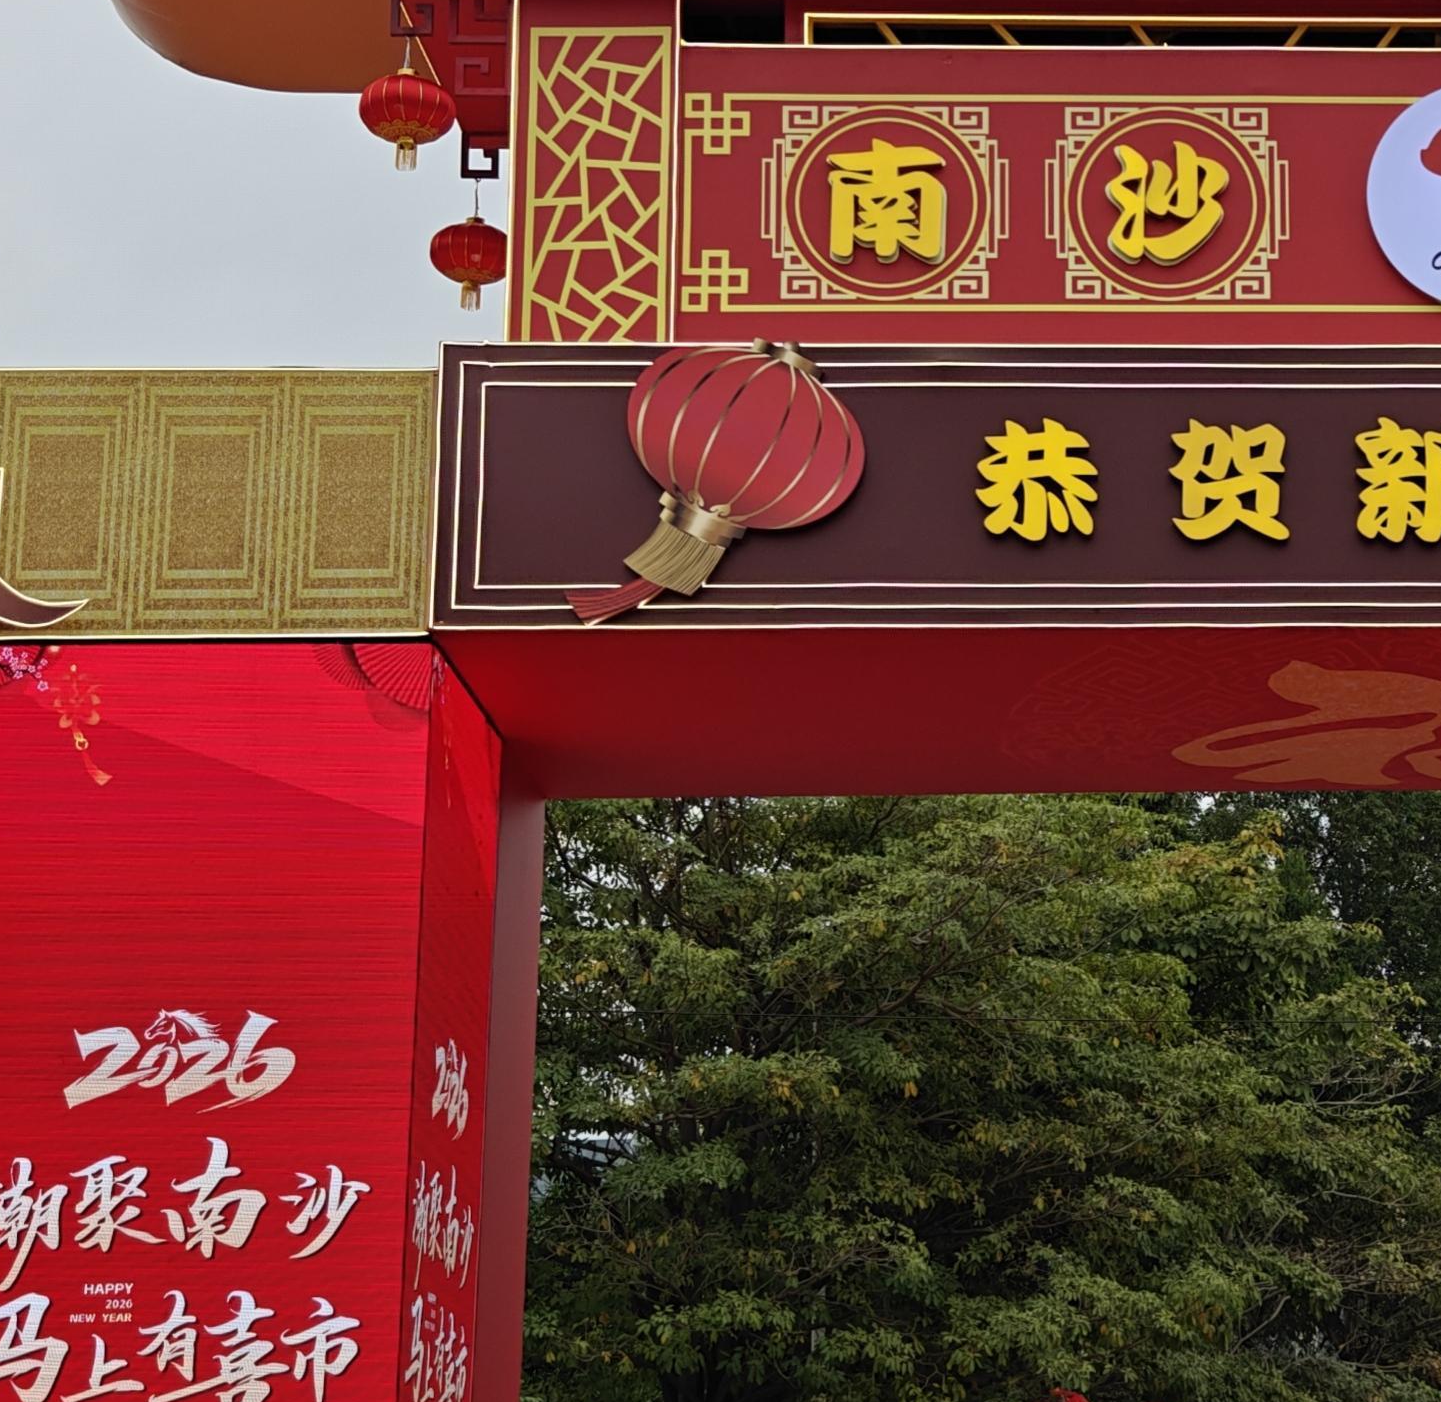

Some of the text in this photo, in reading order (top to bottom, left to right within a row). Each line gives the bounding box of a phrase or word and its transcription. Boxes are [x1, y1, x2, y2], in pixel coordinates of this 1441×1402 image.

[63, 1009, 296, 1113] 2026
[83, 1282, 134, 1295] HAPPY
[105, 1298, 133, 1309] 2026
[68, 1312, 132, 1323] NEW YEAR
